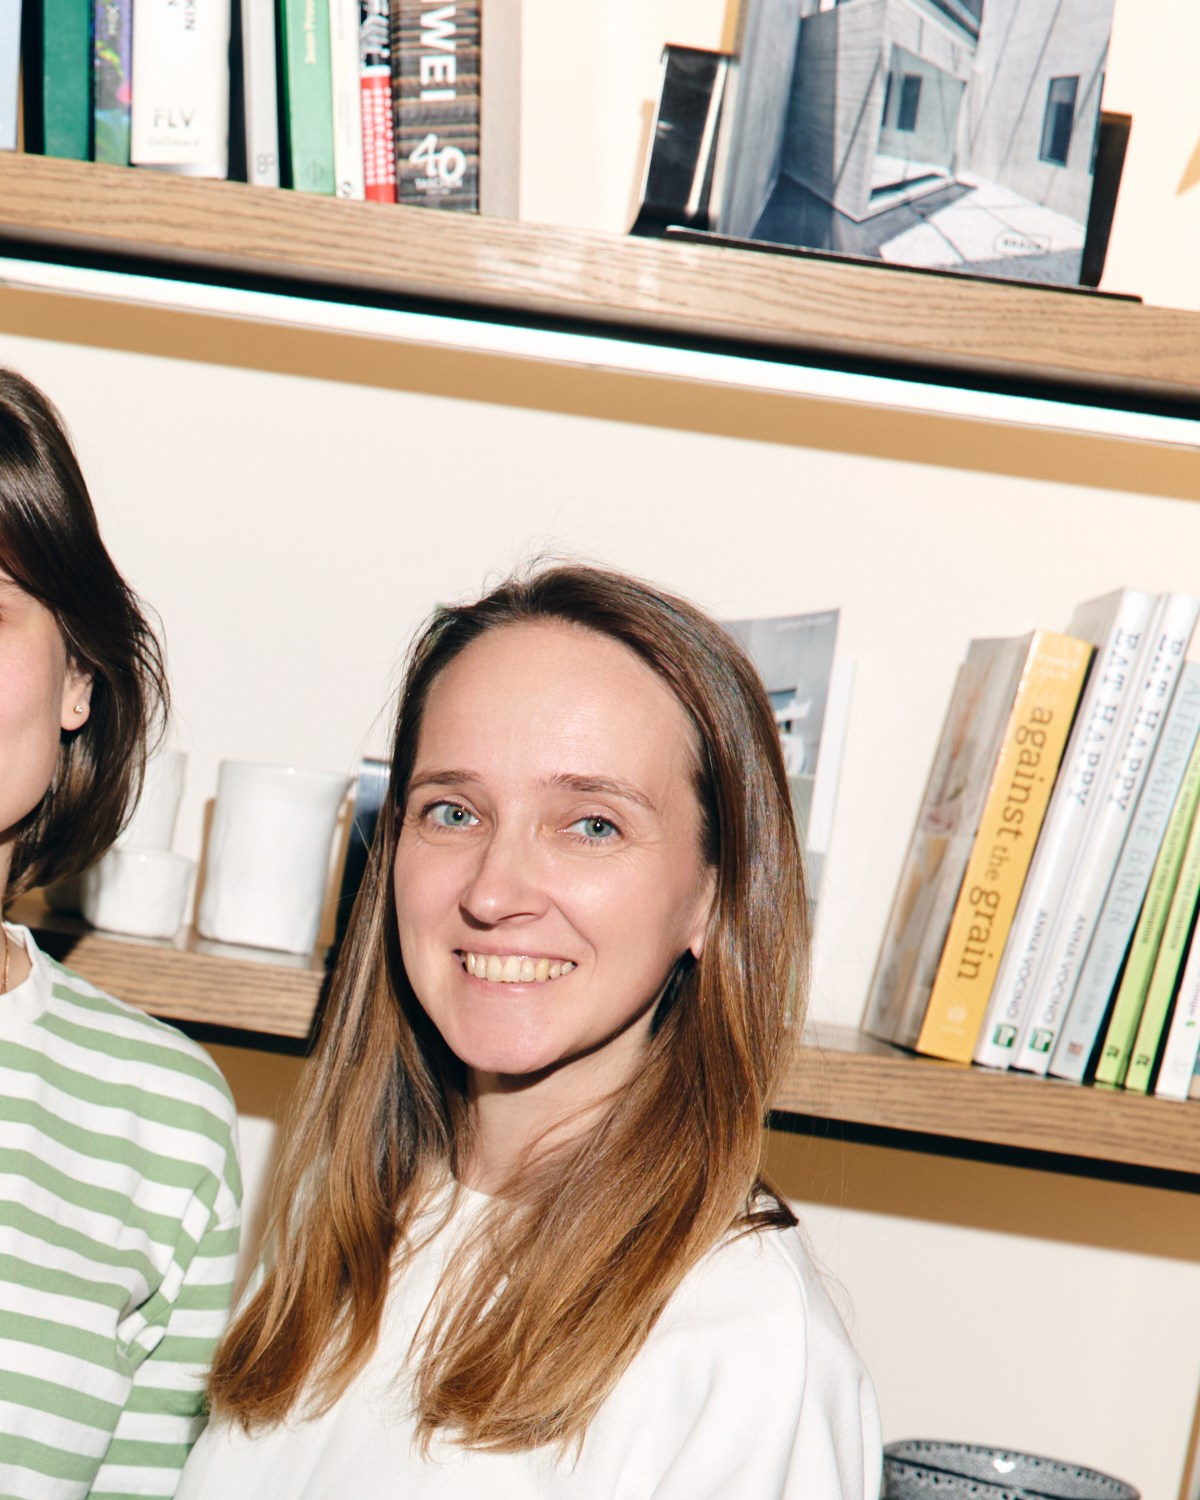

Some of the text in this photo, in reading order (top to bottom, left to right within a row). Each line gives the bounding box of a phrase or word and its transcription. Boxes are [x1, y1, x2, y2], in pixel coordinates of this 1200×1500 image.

[153, 106, 197, 129] FLV
[409, 133, 467, 180] 40
[1068, 629, 1139, 806] EAT HAPPY
[1108, 632, 1184, 812] EAT HAPPY
[956, 706, 1054, 981] against the grain
[1106, 851, 1147, 926] BAKER
